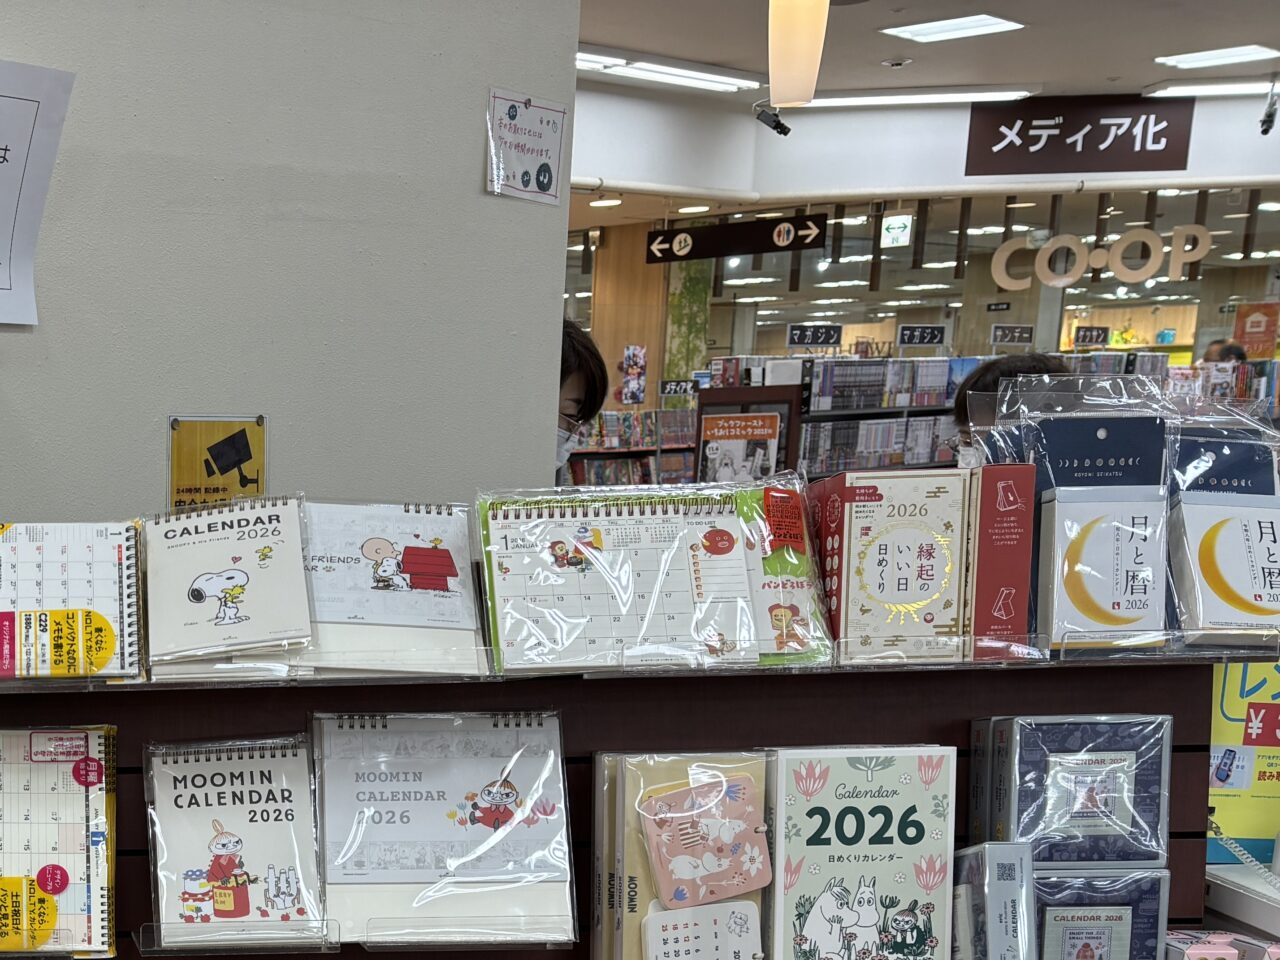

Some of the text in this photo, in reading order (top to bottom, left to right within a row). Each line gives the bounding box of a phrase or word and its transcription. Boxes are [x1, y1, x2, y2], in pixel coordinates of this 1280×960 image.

[991, 115, 1169, 155] メディア化
[792, 328, 839, 345] マガジン
[902, 328, 945, 345] マガジン
[994, 329, 1032, 344] サンデー
[164, 513, 282, 541] CALENDAR
[311, 554, 361, 565] FRIENDS
[1123, 515, 1153, 597] 月と暦
[876, 543, 888, 594] 日めくり
[896, 543, 911, 592] いい日
[916, 543, 936, 592] 縁起の
[172, 769, 273, 790] MOOMIN
[354, 770, 424, 783] MOOMIN
[173, 787, 294, 809] CALENDAR
[355, 788, 447, 803] CALENDAR
[834, 783, 901, 801] Calendar
[248, 808, 296, 824] 2026
[805, 804, 926, 847] 2026
[827, 853, 905, 864] 日めくりカレンダー
[627, 875, 639, 914] MOOMIN
[10, 890, 22, 936] 土日祝日が
